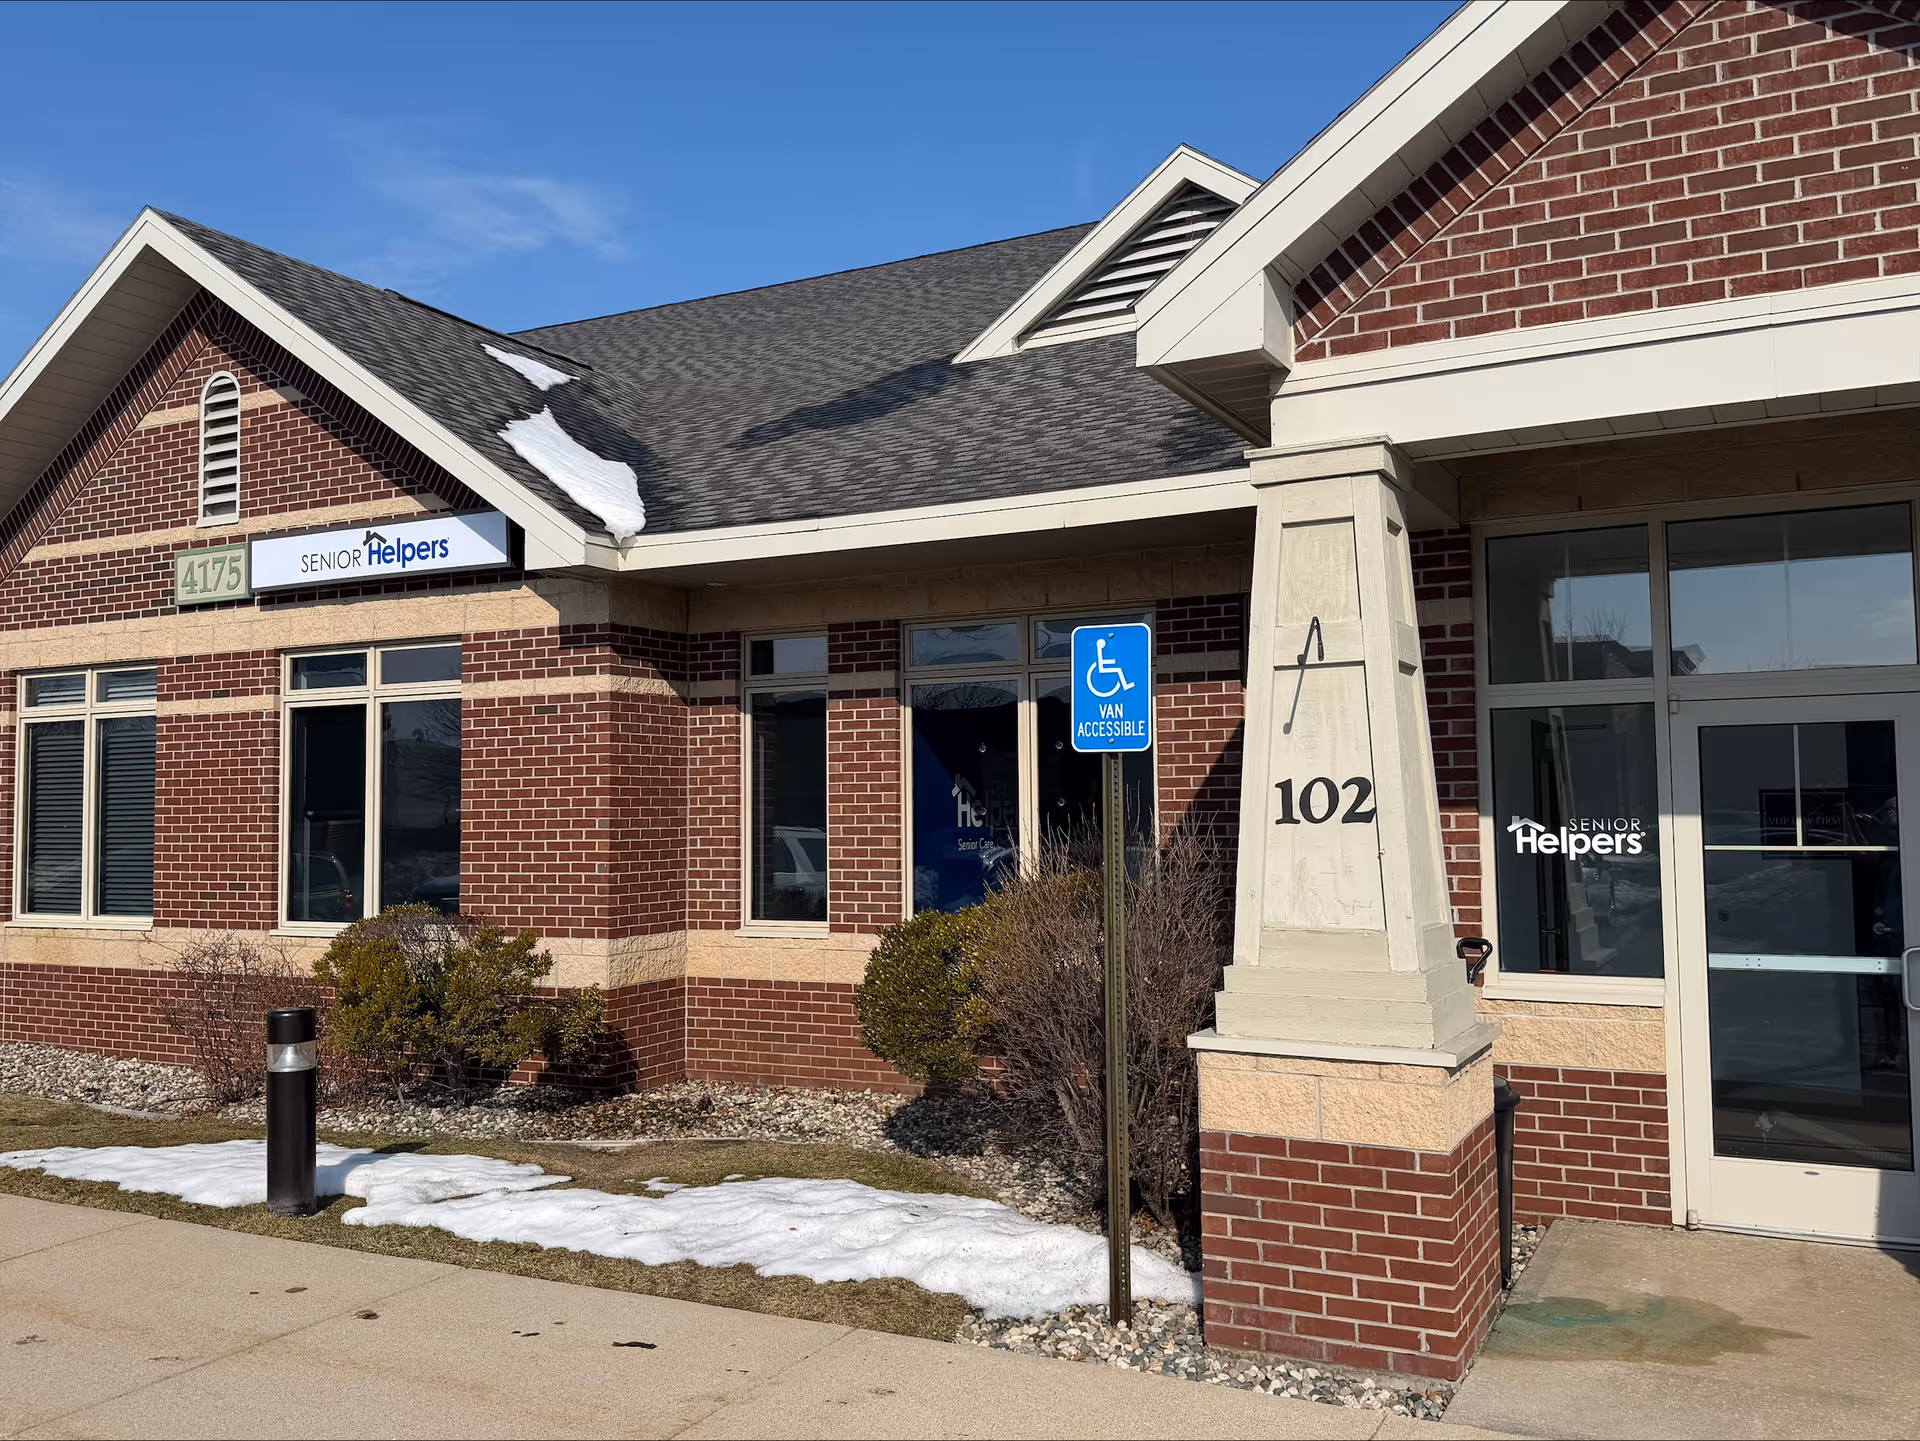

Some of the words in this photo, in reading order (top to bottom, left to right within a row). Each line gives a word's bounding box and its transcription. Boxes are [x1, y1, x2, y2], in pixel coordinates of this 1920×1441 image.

[301, 549, 361, 573] SENIOR
[368, 537, 449, 568] Helpers
[181, 555, 242, 595] 4175
[1099, 703, 1124, 719] VAN
[1077, 720, 1146, 737] ACCESSIBLE
[1274, 776, 1377, 825] 102
[1569, 817, 1641, 832] SENIOR
[957, 838, 977, 852] Senior
[1516, 826, 1643, 860] Helpers
